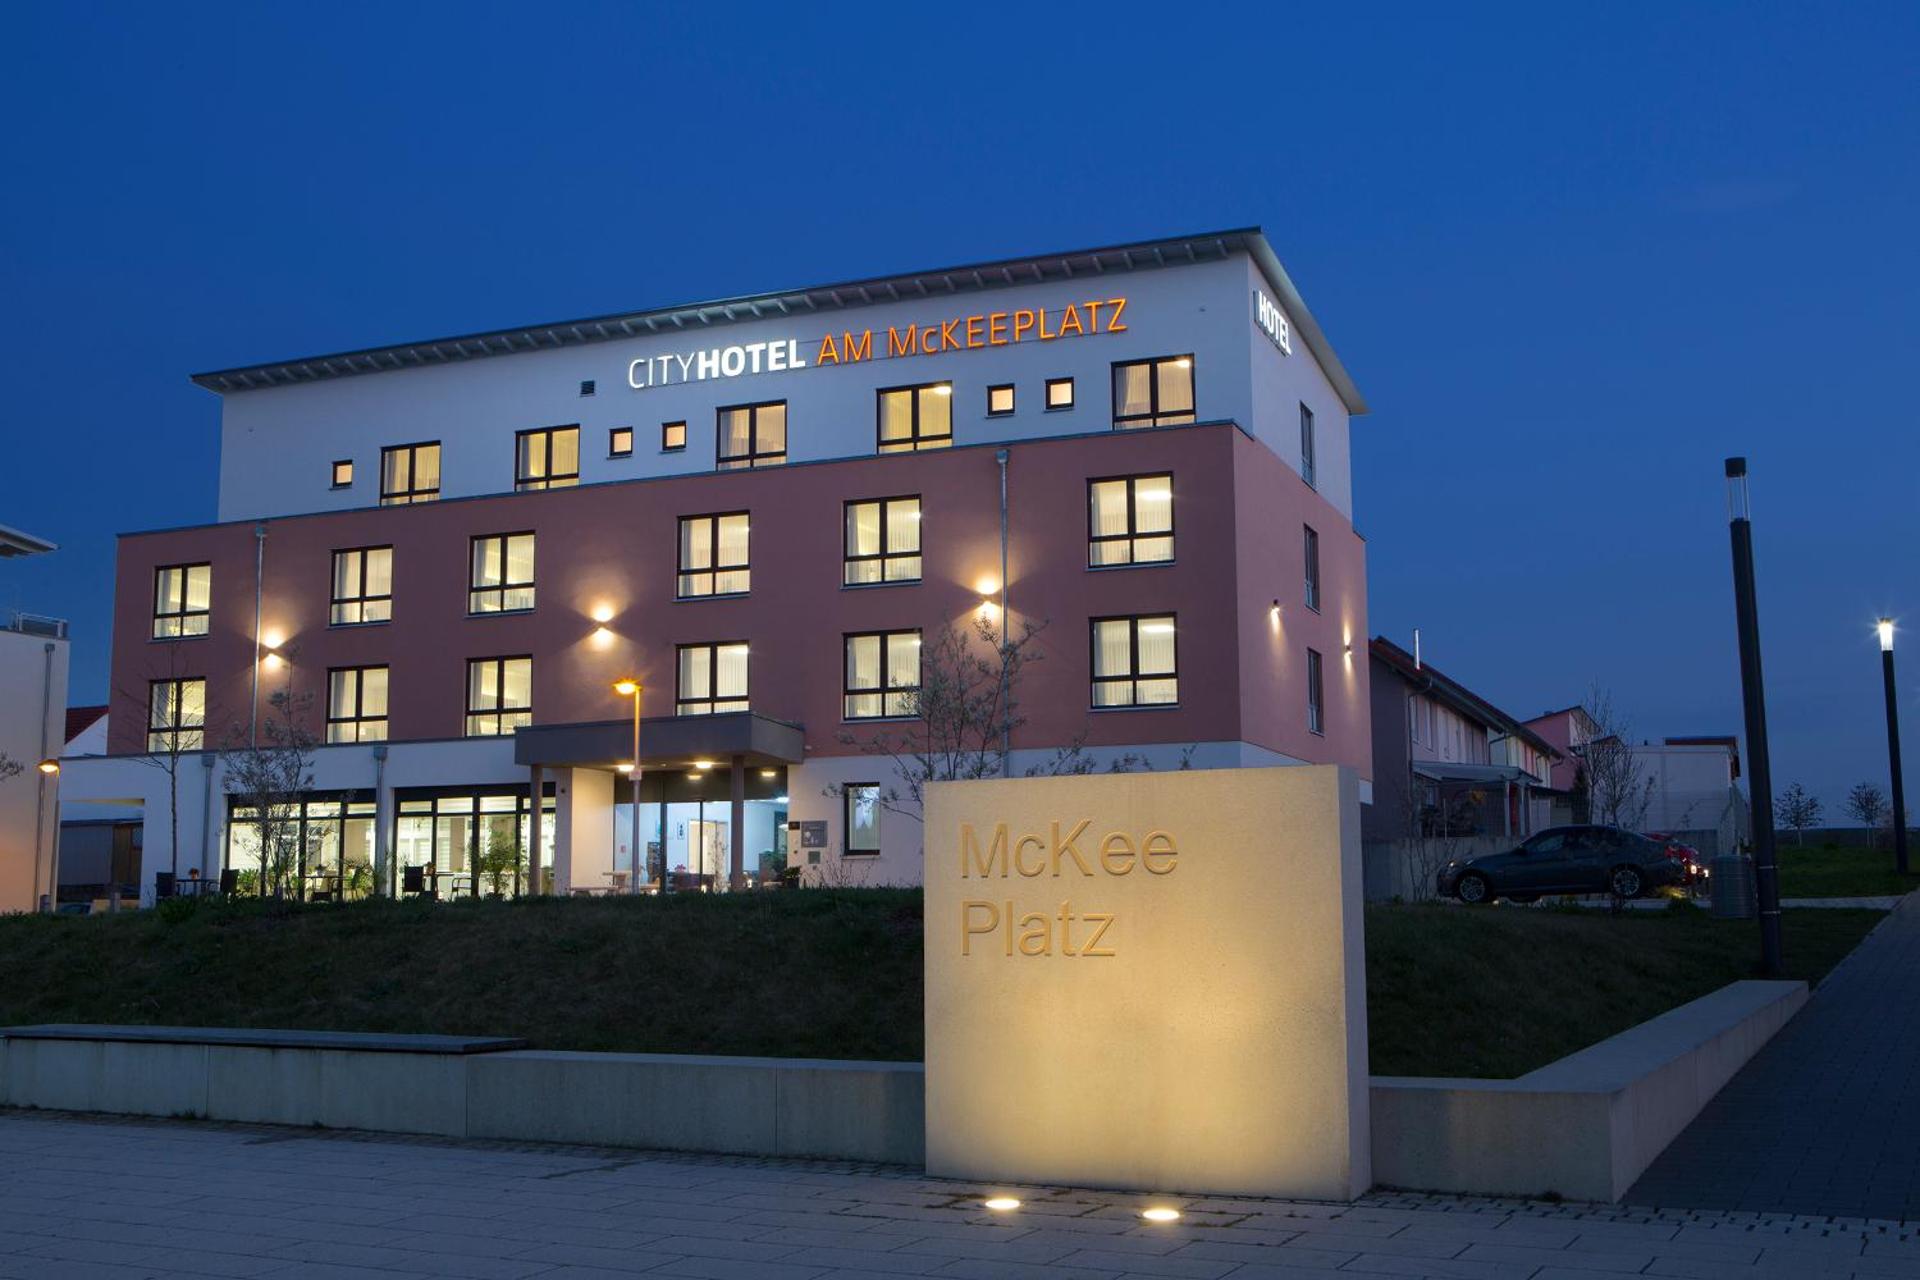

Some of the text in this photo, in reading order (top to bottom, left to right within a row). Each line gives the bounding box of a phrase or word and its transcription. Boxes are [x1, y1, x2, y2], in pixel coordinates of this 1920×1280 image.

[628, 298, 1128, 389] CITYHOTEL AM McKEEPLATZ
[1258, 290, 1292, 355] HOTEL
[960, 819, 1178, 879] McKee
[961, 900, 1116, 957] Platz
